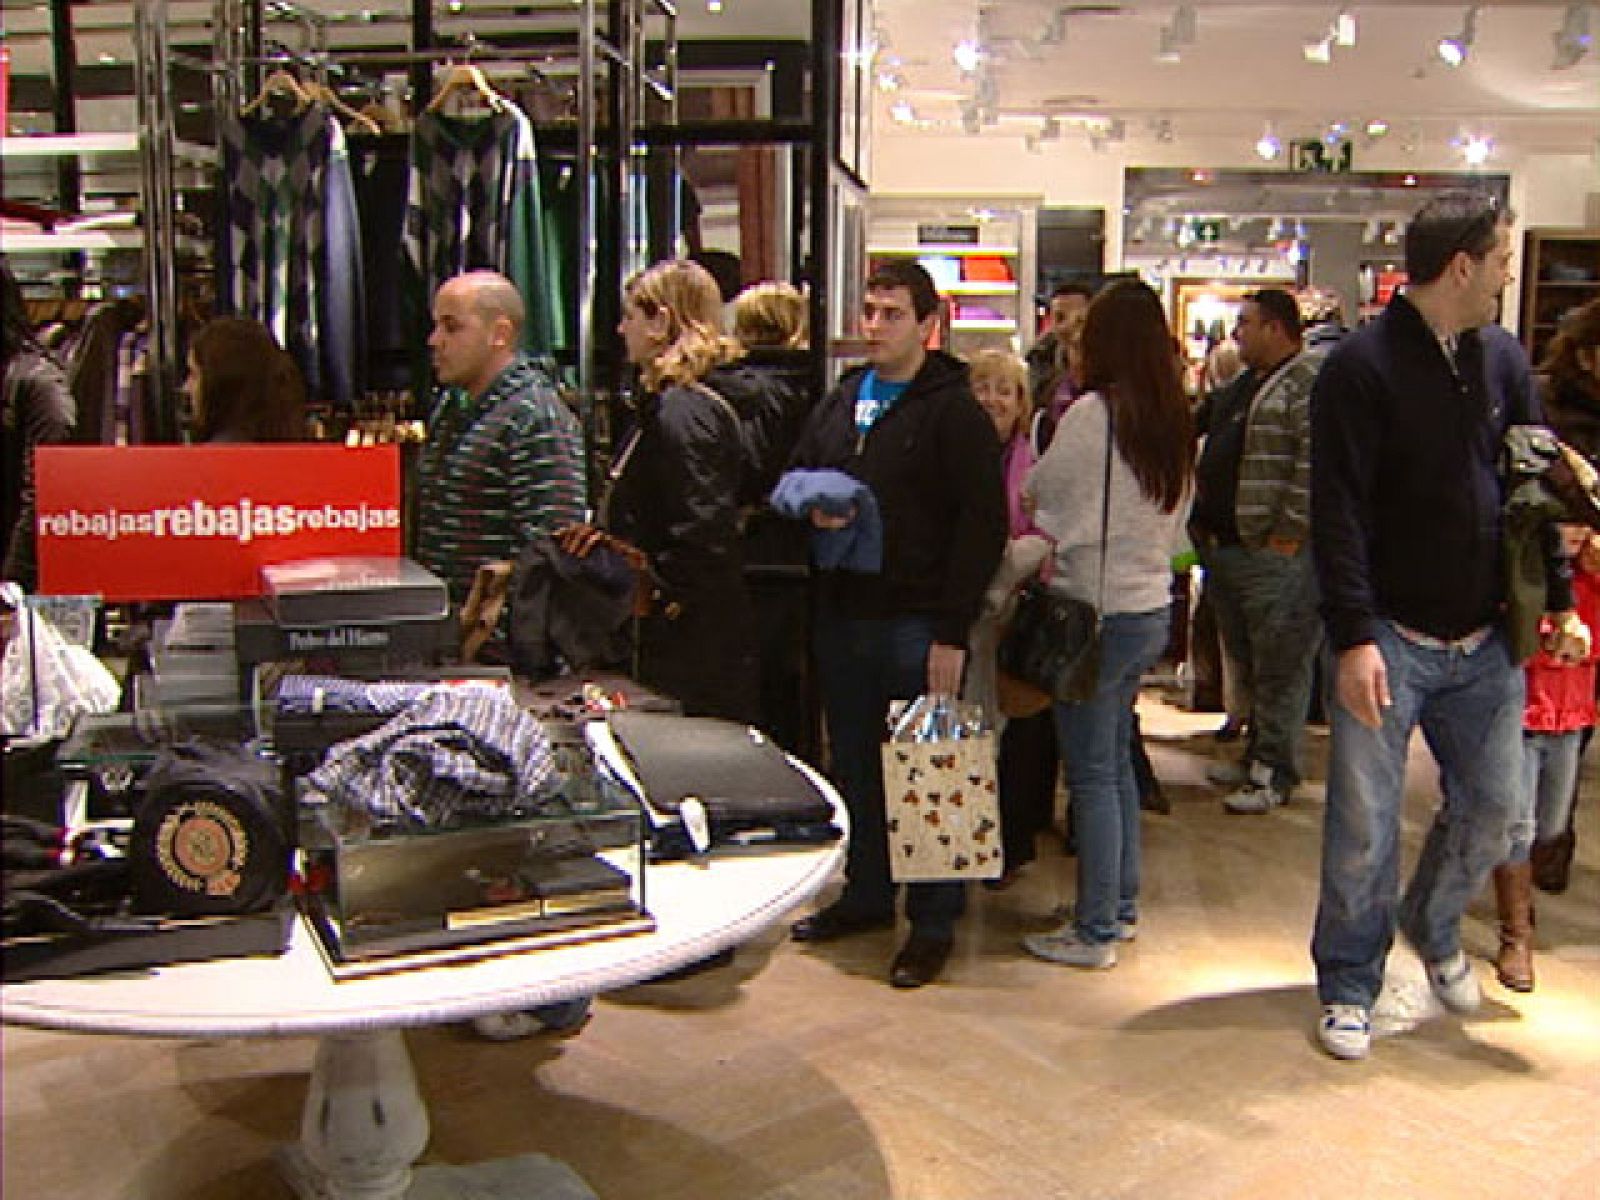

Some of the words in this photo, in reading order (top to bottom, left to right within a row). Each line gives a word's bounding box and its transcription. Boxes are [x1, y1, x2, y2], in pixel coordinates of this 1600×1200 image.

[39, 507, 153, 540] rebajas
[153, 499, 296, 543] rebajas
[297, 502, 399, 533] rebajas
